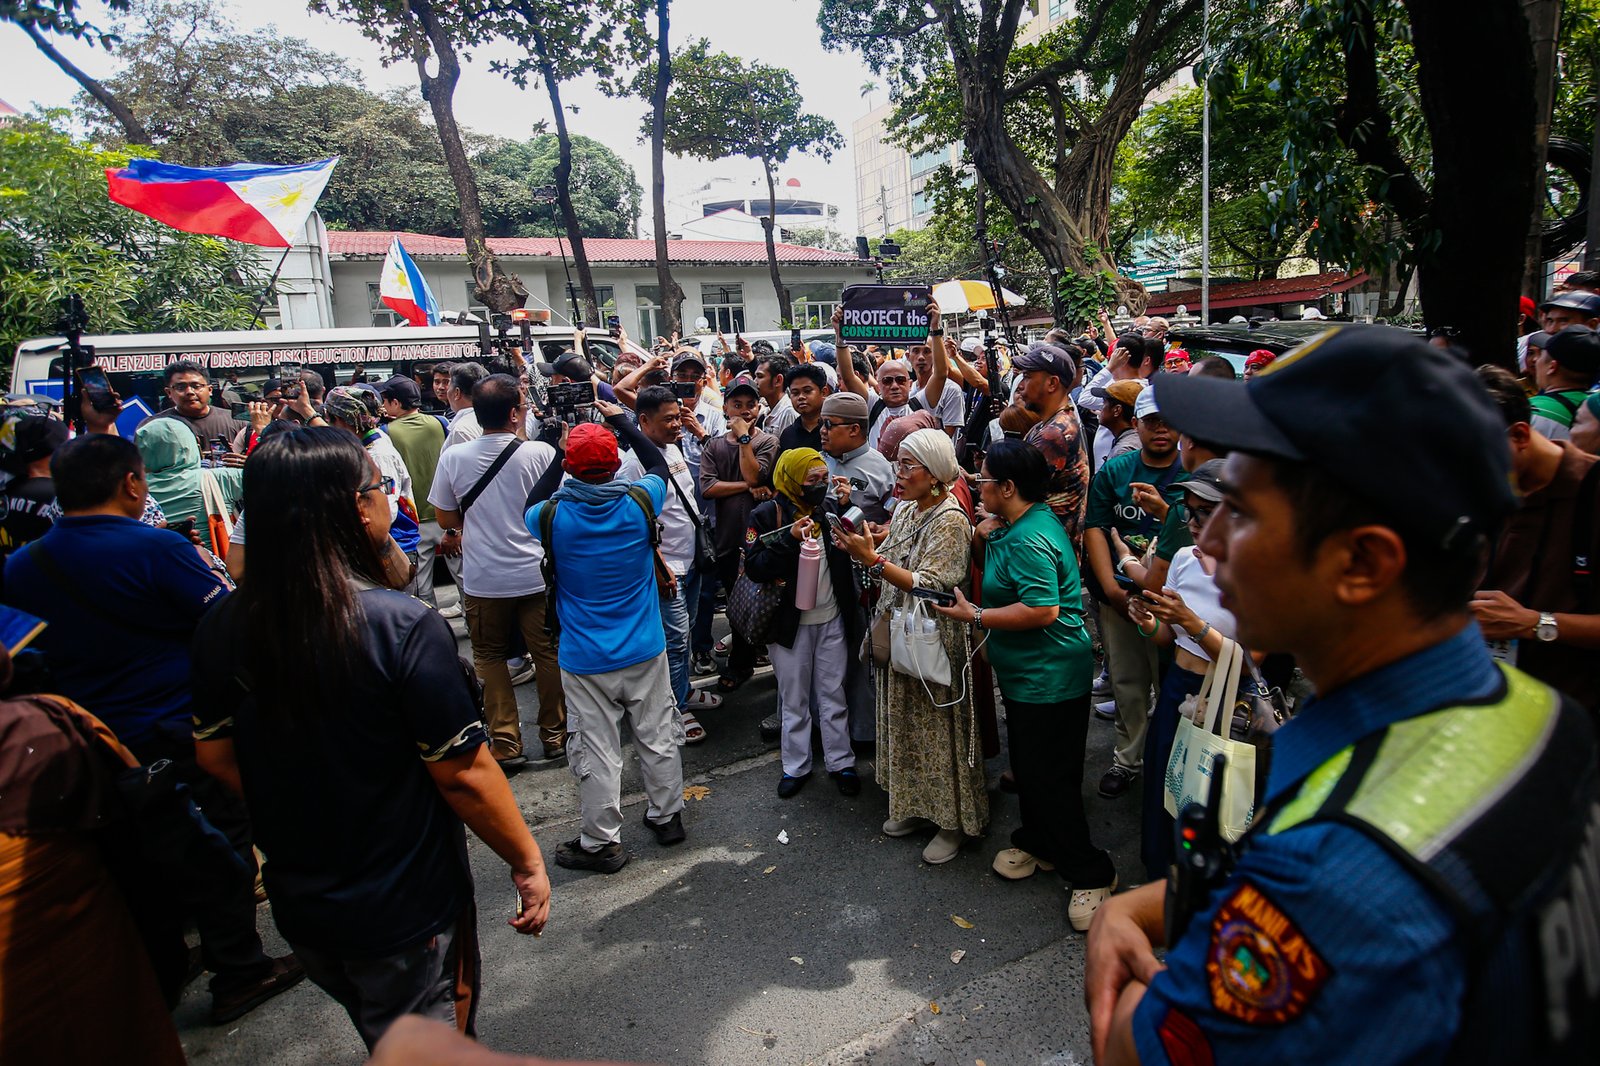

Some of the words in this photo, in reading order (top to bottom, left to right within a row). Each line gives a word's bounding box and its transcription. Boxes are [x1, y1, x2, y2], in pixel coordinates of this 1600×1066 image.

[843, 309, 903, 325] PROTECT
[906, 309, 928, 325] the
[841, 326, 928, 337] CONSTITUTION
[210, 350, 272, 368] DISASTER
[272, 349, 302, 366] RISK
[300, 347, 366, 365] REDUCTION
[366, 346, 391, 362] AND
[391, 344, 463, 360] MANAGEMENT
[10, 497, 37, 513] NOT
